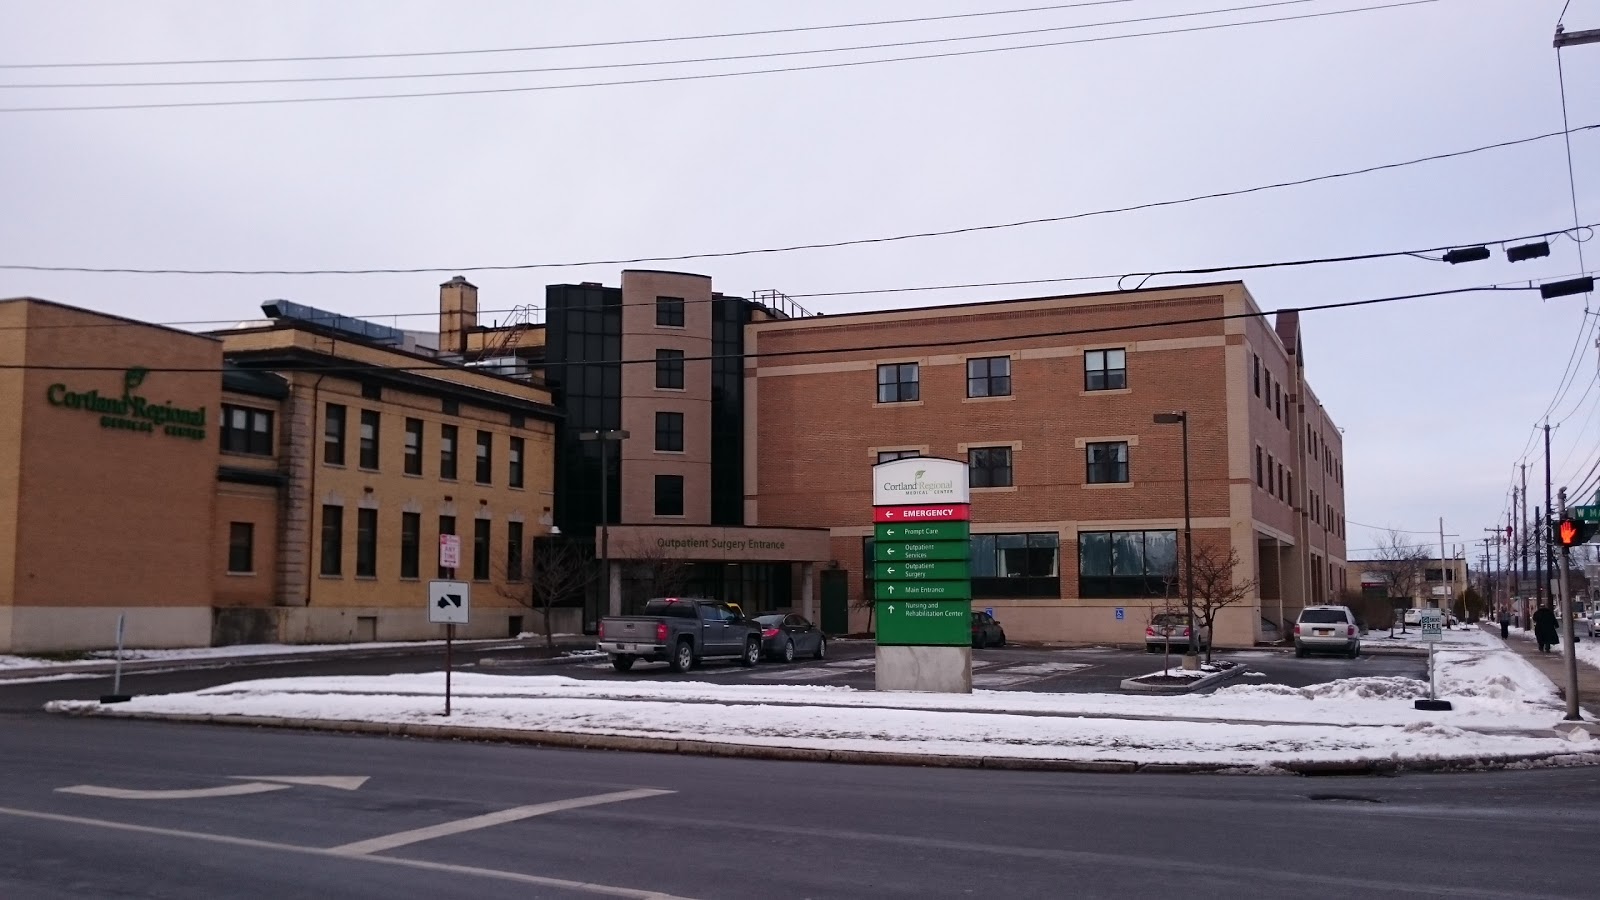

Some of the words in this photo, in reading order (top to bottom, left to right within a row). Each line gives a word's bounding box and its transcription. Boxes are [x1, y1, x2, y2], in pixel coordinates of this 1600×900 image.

[48, 383, 129, 413] Cortland
[132, 396, 206, 426] Regional
[100, 415, 153, 432] MEDICAL
[164, 425, 206, 440] CENTER
[883, 481, 917, 491] Cortland
[918, 480, 953, 491] Regional
[903, 509, 953, 517] EMERGENCY
[1576, 508, 1585, 518] W
[657, 538, 709, 549] Outpatient
[711, 538, 746, 551] Surgery
[748, 539, 785, 549] Entrance
[905, 543, 934, 551] Outpatient
[905, 562, 935, 570] Outpatient
[905, 602, 927, 610] Nursing
